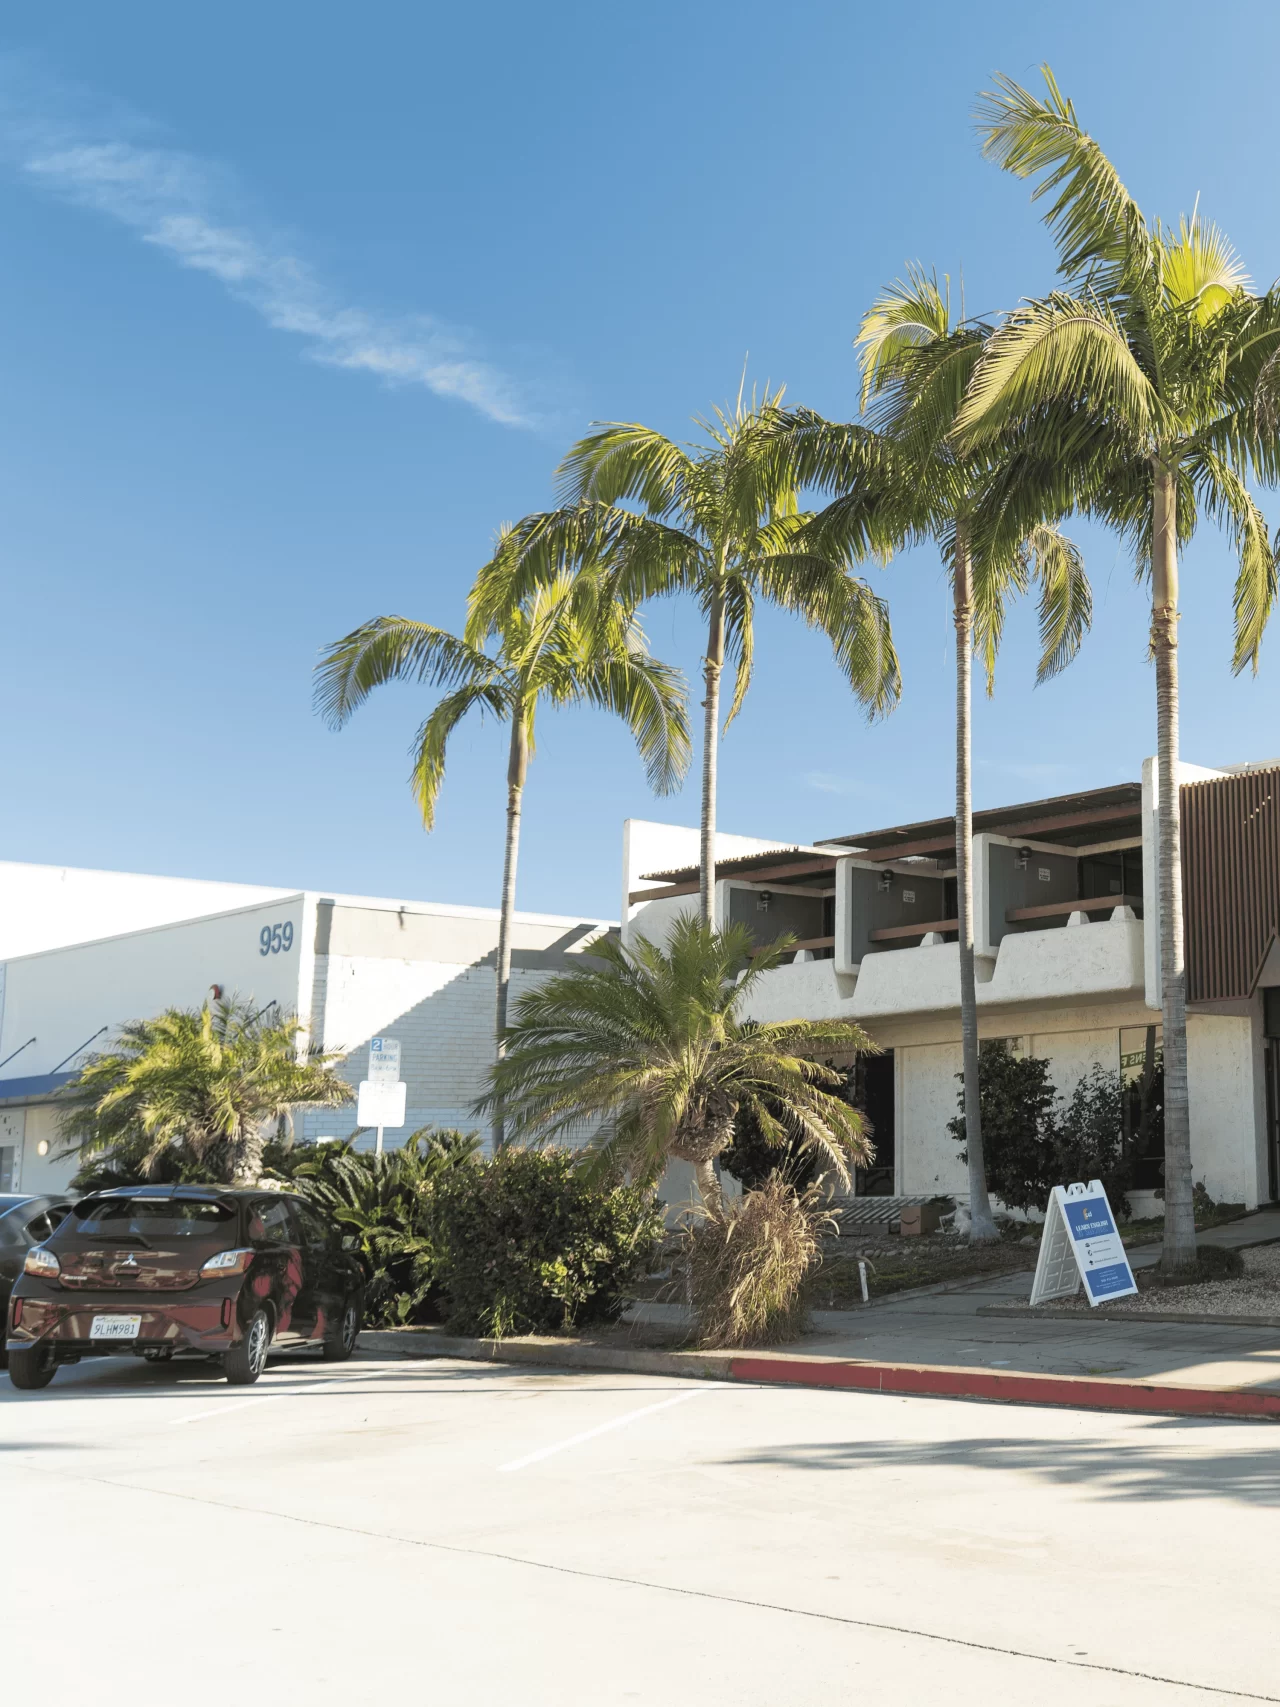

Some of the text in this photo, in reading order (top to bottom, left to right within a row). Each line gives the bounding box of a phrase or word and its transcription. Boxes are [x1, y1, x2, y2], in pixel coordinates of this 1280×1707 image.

[260, 921, 293, 956] 959
[373, 1040, 380, 1050] 2
[372, 1054, 397, 1062] PARKING
[1090, 1220, 1108, 1228] ENGLISH
[94, 1324, 135, 1335] 9LHM981
